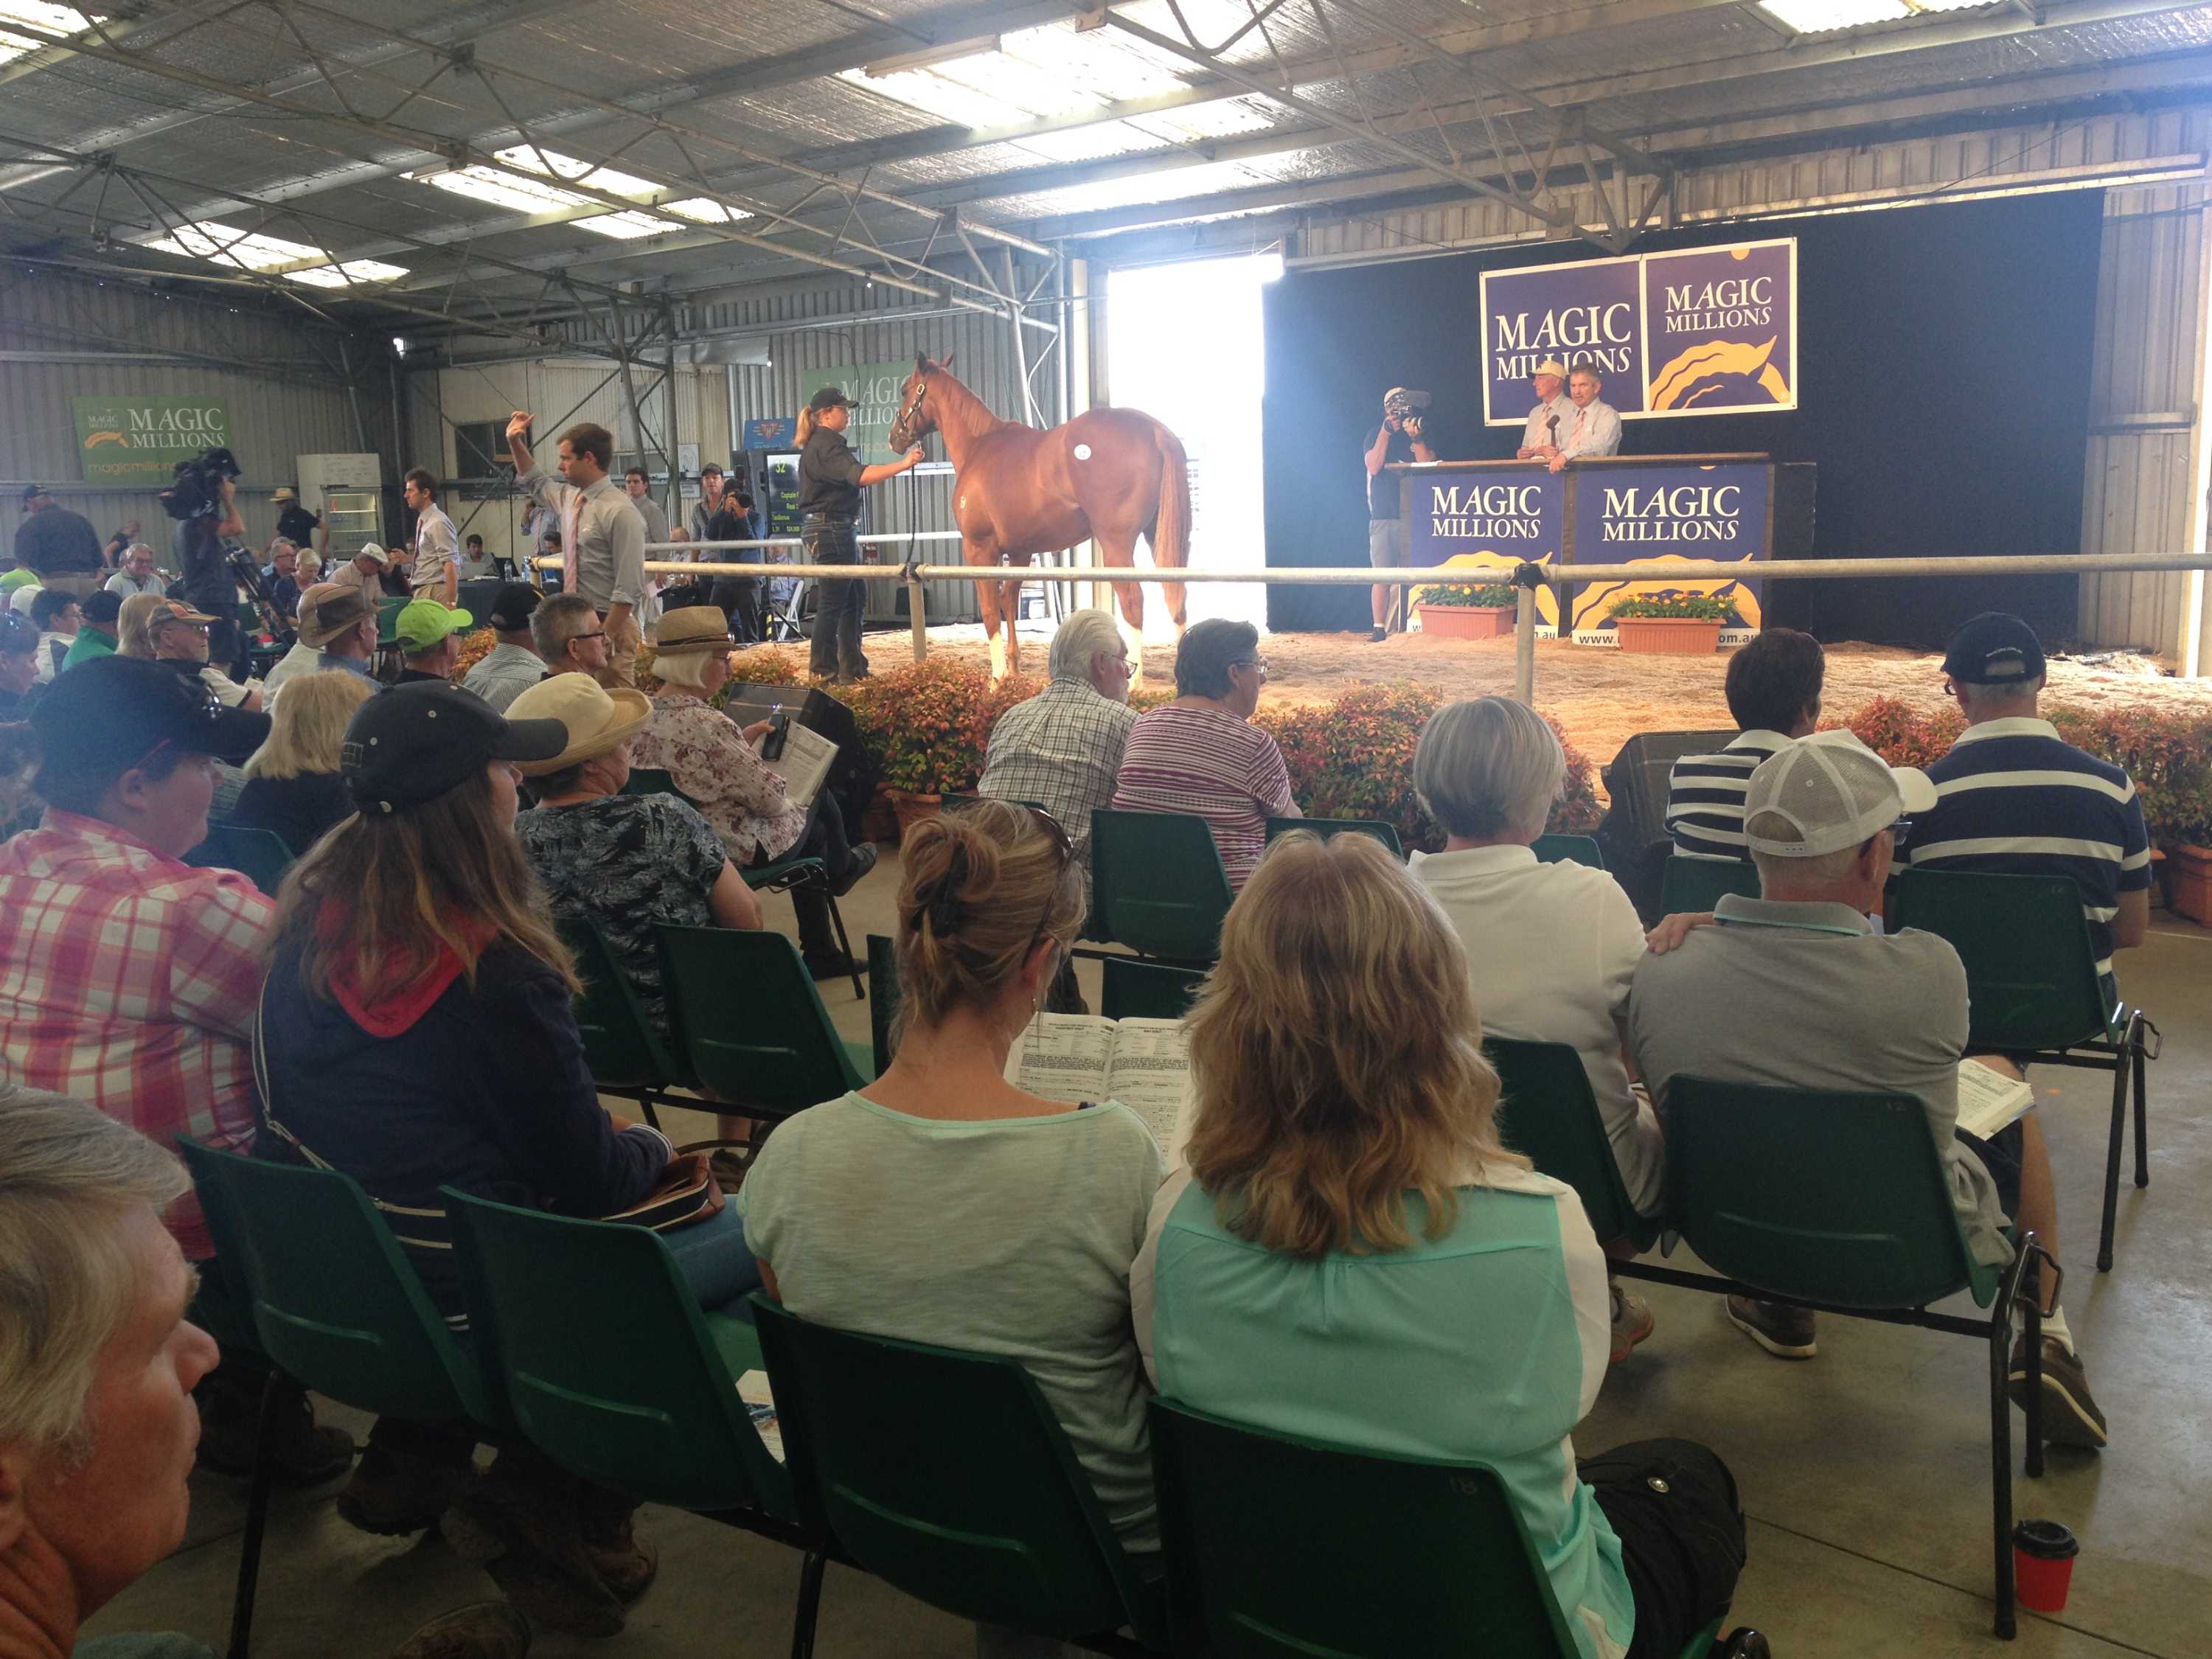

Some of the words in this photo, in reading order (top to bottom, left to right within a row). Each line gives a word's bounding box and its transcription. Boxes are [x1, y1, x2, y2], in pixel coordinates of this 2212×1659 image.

[1664, 276, 1773, 313] MAGIC
[1495, 302, 1632, 352] MAGIC
[1665, 306, 1773, 333] MILLIONS
[1495, 347, 1632, 380] MILIONS
[127, 407, 224, 431] MAGIC
[131, 432, 226, 448] MILLIONS
[775, 459, 786, 473] 32
[1431, 485, 1541, 516] MAGIC
[1601, 486, 1741, 518] MAGIC
[1431, 518, 1541, 538] MILLIONS
[1601, 520, 1740, 542] MILLIONS
